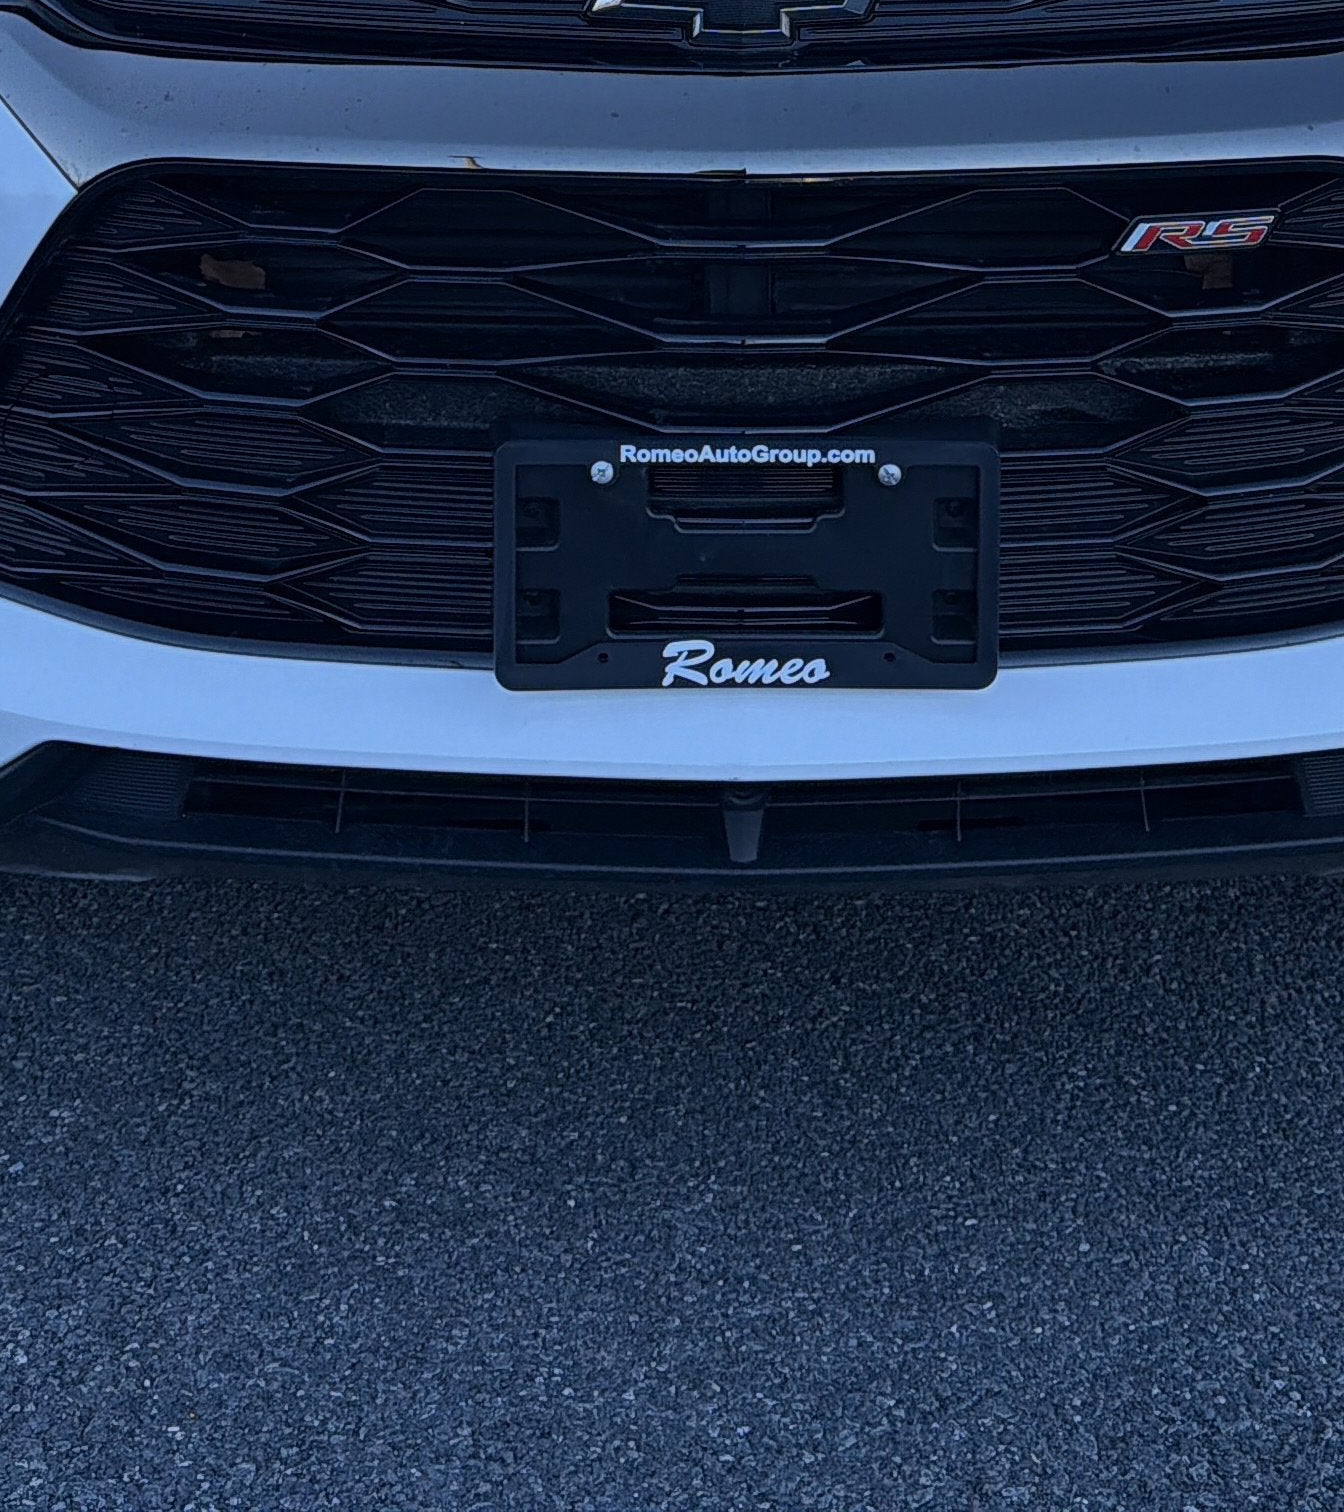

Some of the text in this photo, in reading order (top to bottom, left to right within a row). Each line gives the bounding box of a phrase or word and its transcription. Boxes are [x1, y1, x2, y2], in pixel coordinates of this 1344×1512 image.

[1120, 215, 1275, 252] RS
[619, 444, 876, 466] RomeoAutoGroup.com
[661, 639, 831, 687] Romeo
